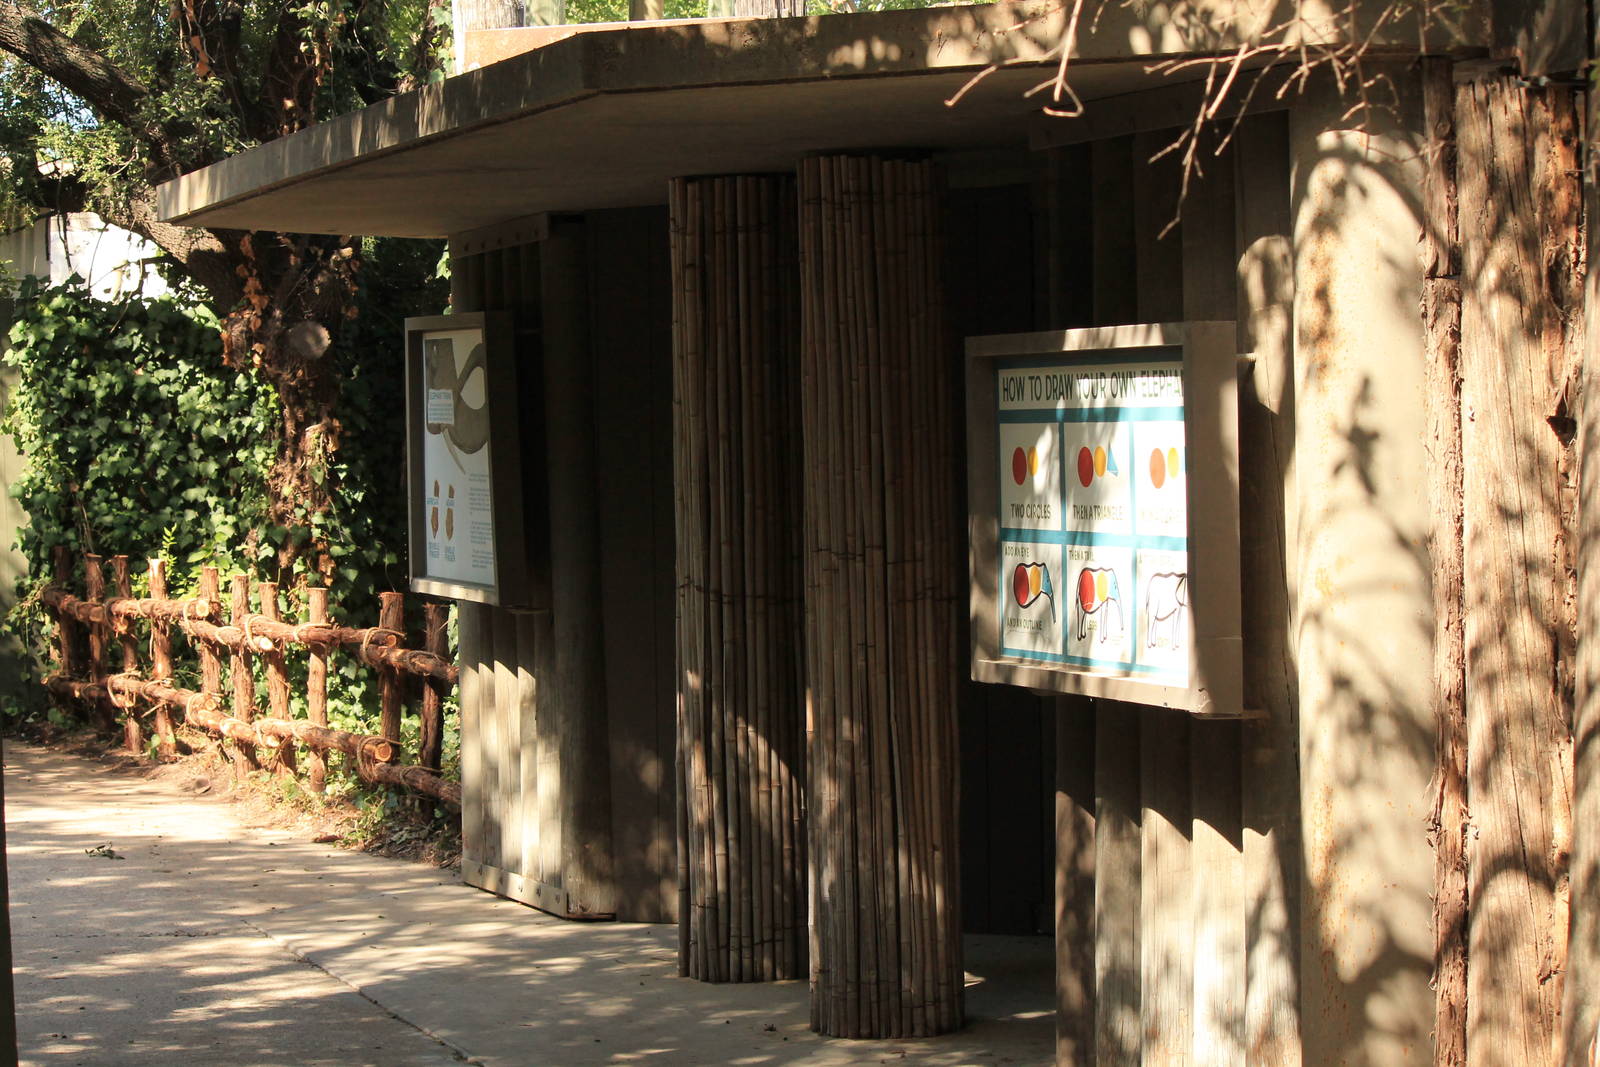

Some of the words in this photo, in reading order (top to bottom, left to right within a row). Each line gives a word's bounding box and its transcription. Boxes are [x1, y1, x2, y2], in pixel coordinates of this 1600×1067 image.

[1002, 376, 1025, 402] HOW
[1028, 375, 1042, 401] TO
[1045, 374, 1073, 401] DRAW
[1076, 372, 1106, 400] YOUR
[1110, 371, 1136, 399] OWN
[1011, 504, 1025, 519] TWO
[1026, 504, 1050, 520] CIRCLES
[1073, 505, 1088, 520] THEN
